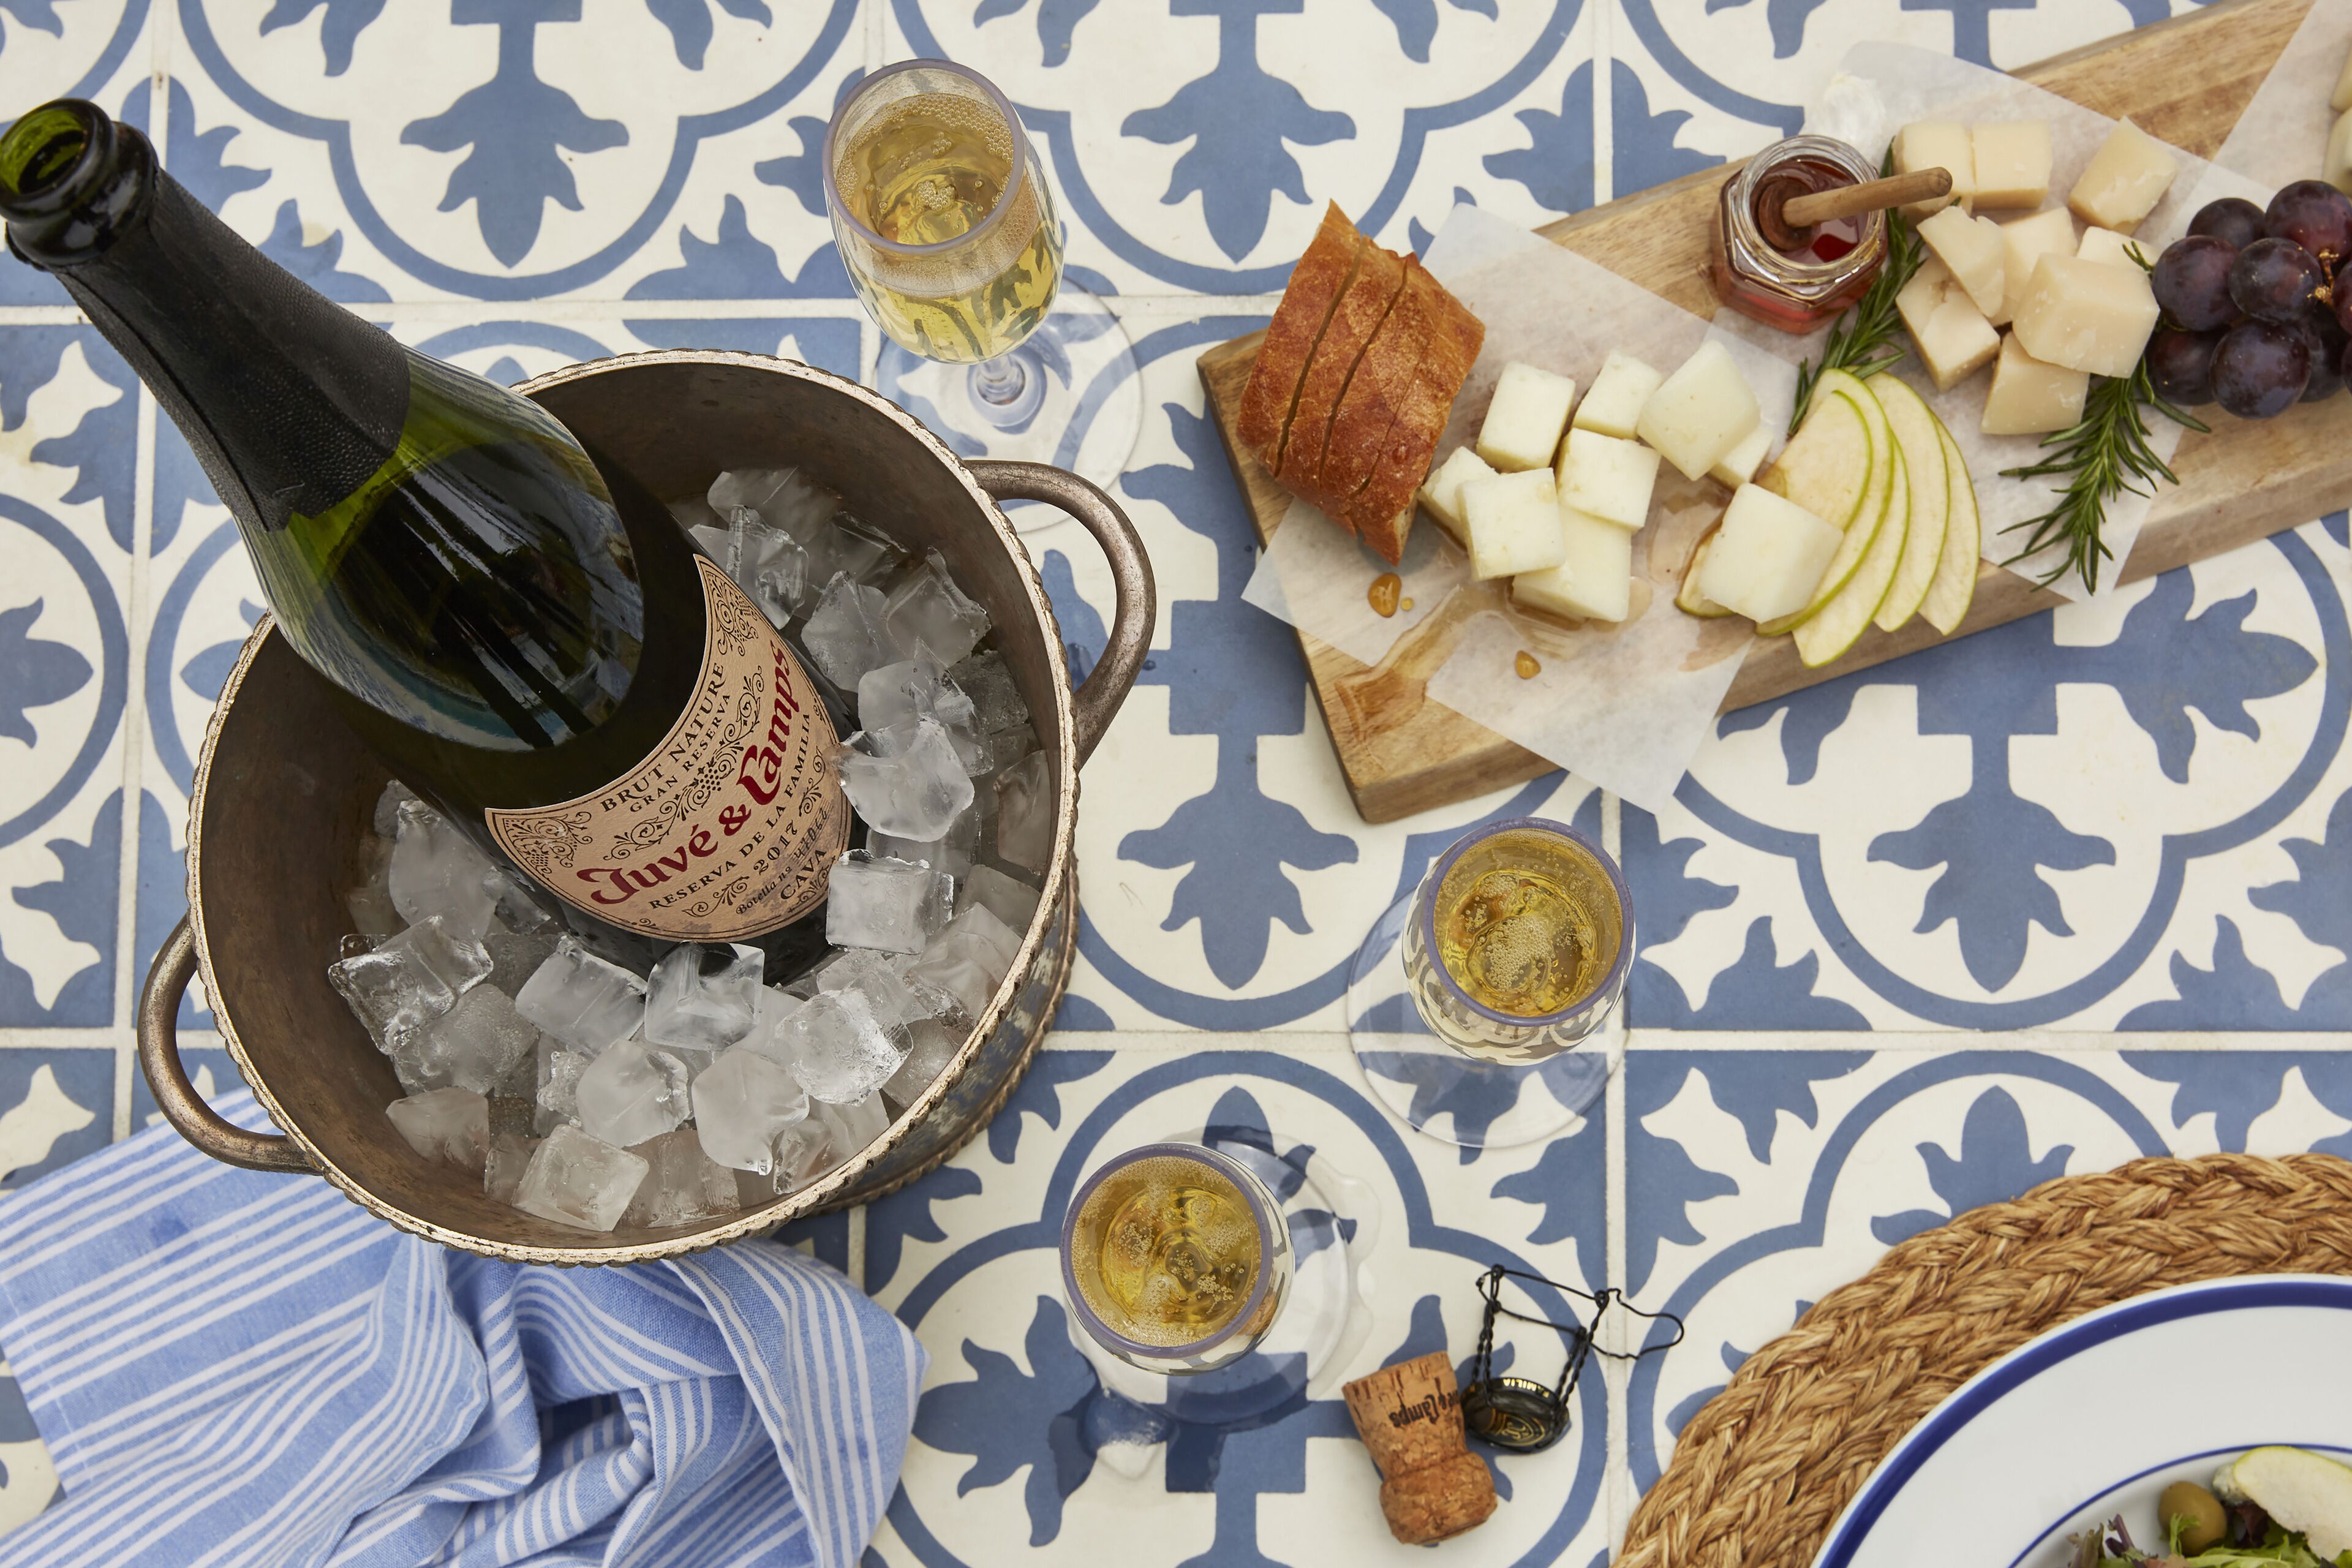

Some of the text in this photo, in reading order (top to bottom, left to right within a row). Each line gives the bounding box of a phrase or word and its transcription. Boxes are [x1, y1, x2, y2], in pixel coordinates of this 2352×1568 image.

[576, 639, 800, 905] Juvé & Camps
[600, 662, 726, 812] BRUT NATURE
[630, 693, 731, 812] GRAN RESERVA
[649, 712, 810, 910] RESERVA DE LA FAMILIA
[753, 820, 797, 876] 2017
[736, 881, 777, 914] Botella
[780, 848, 827, 900] CAVA
[1502, 1378, 1550, 1398] FAMILIA
